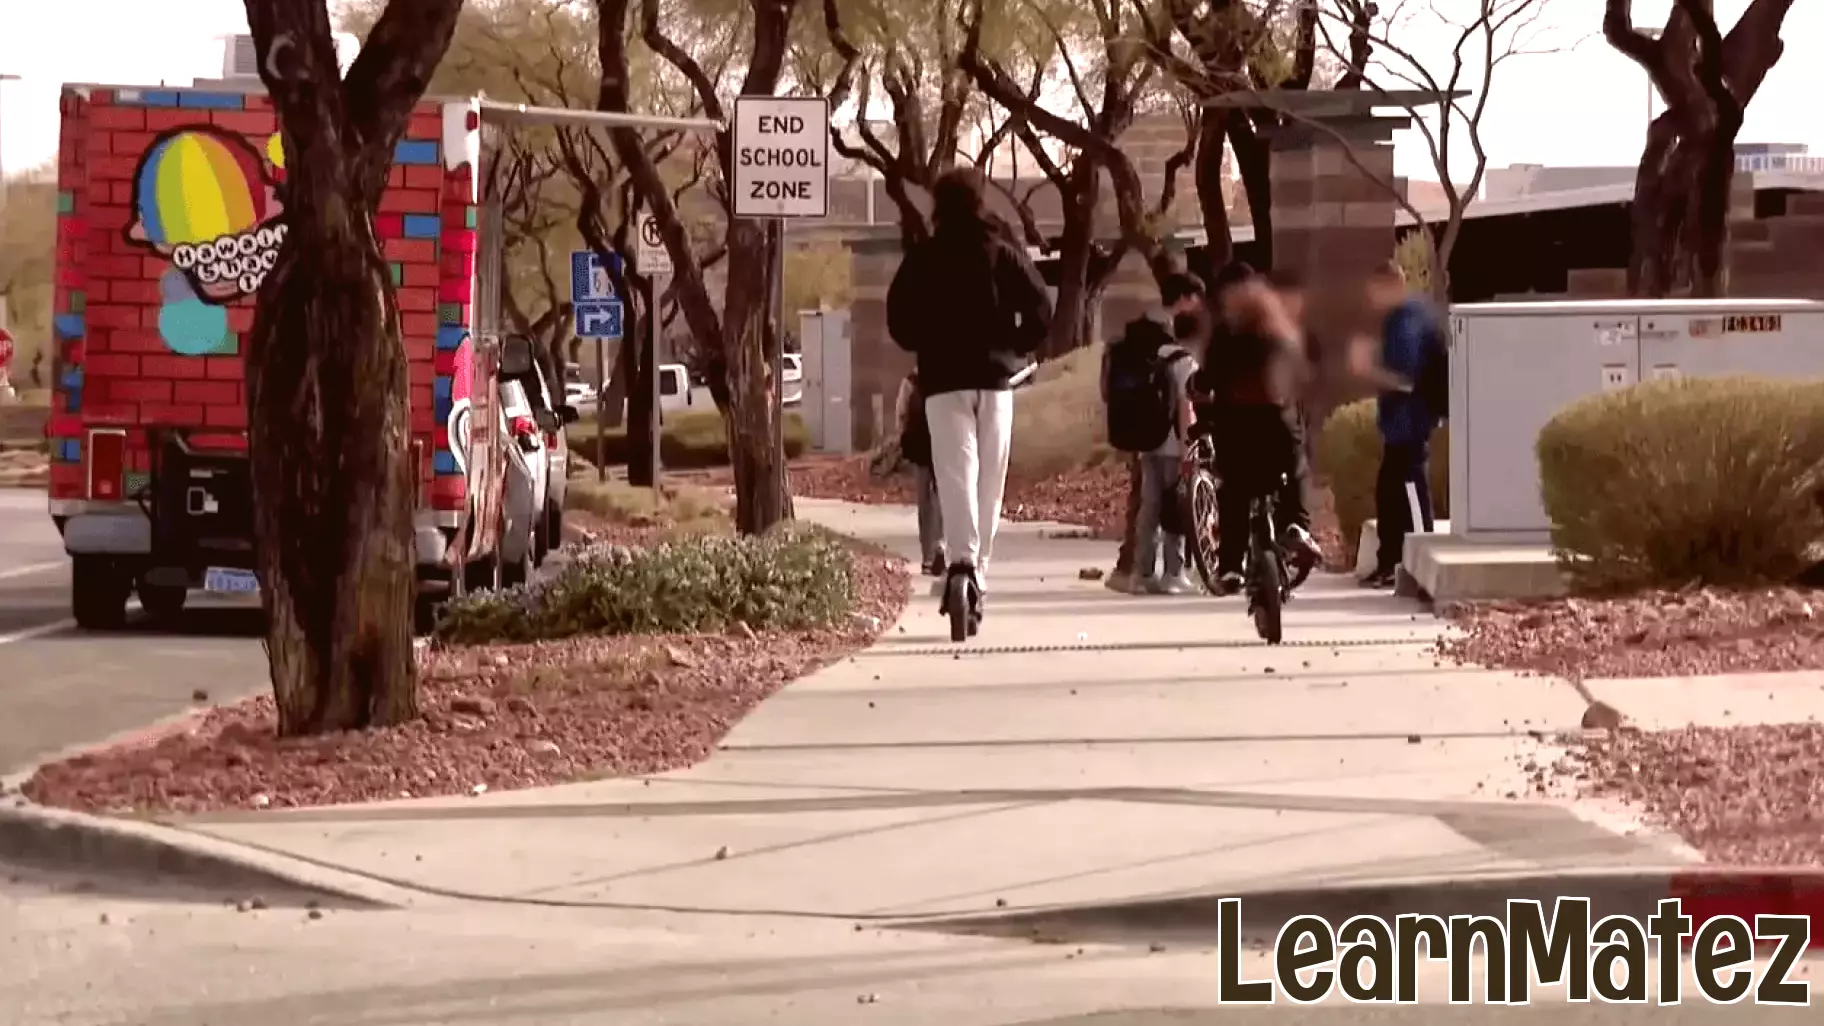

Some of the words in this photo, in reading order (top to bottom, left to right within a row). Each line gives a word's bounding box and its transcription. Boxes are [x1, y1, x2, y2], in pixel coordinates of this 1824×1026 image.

[758, 115, 804, 134] END
[740, 148, 821, 167] SCHOOL
[750, 180, 812, 200] ZONE
[174, 225, 288, 267] Hawai
